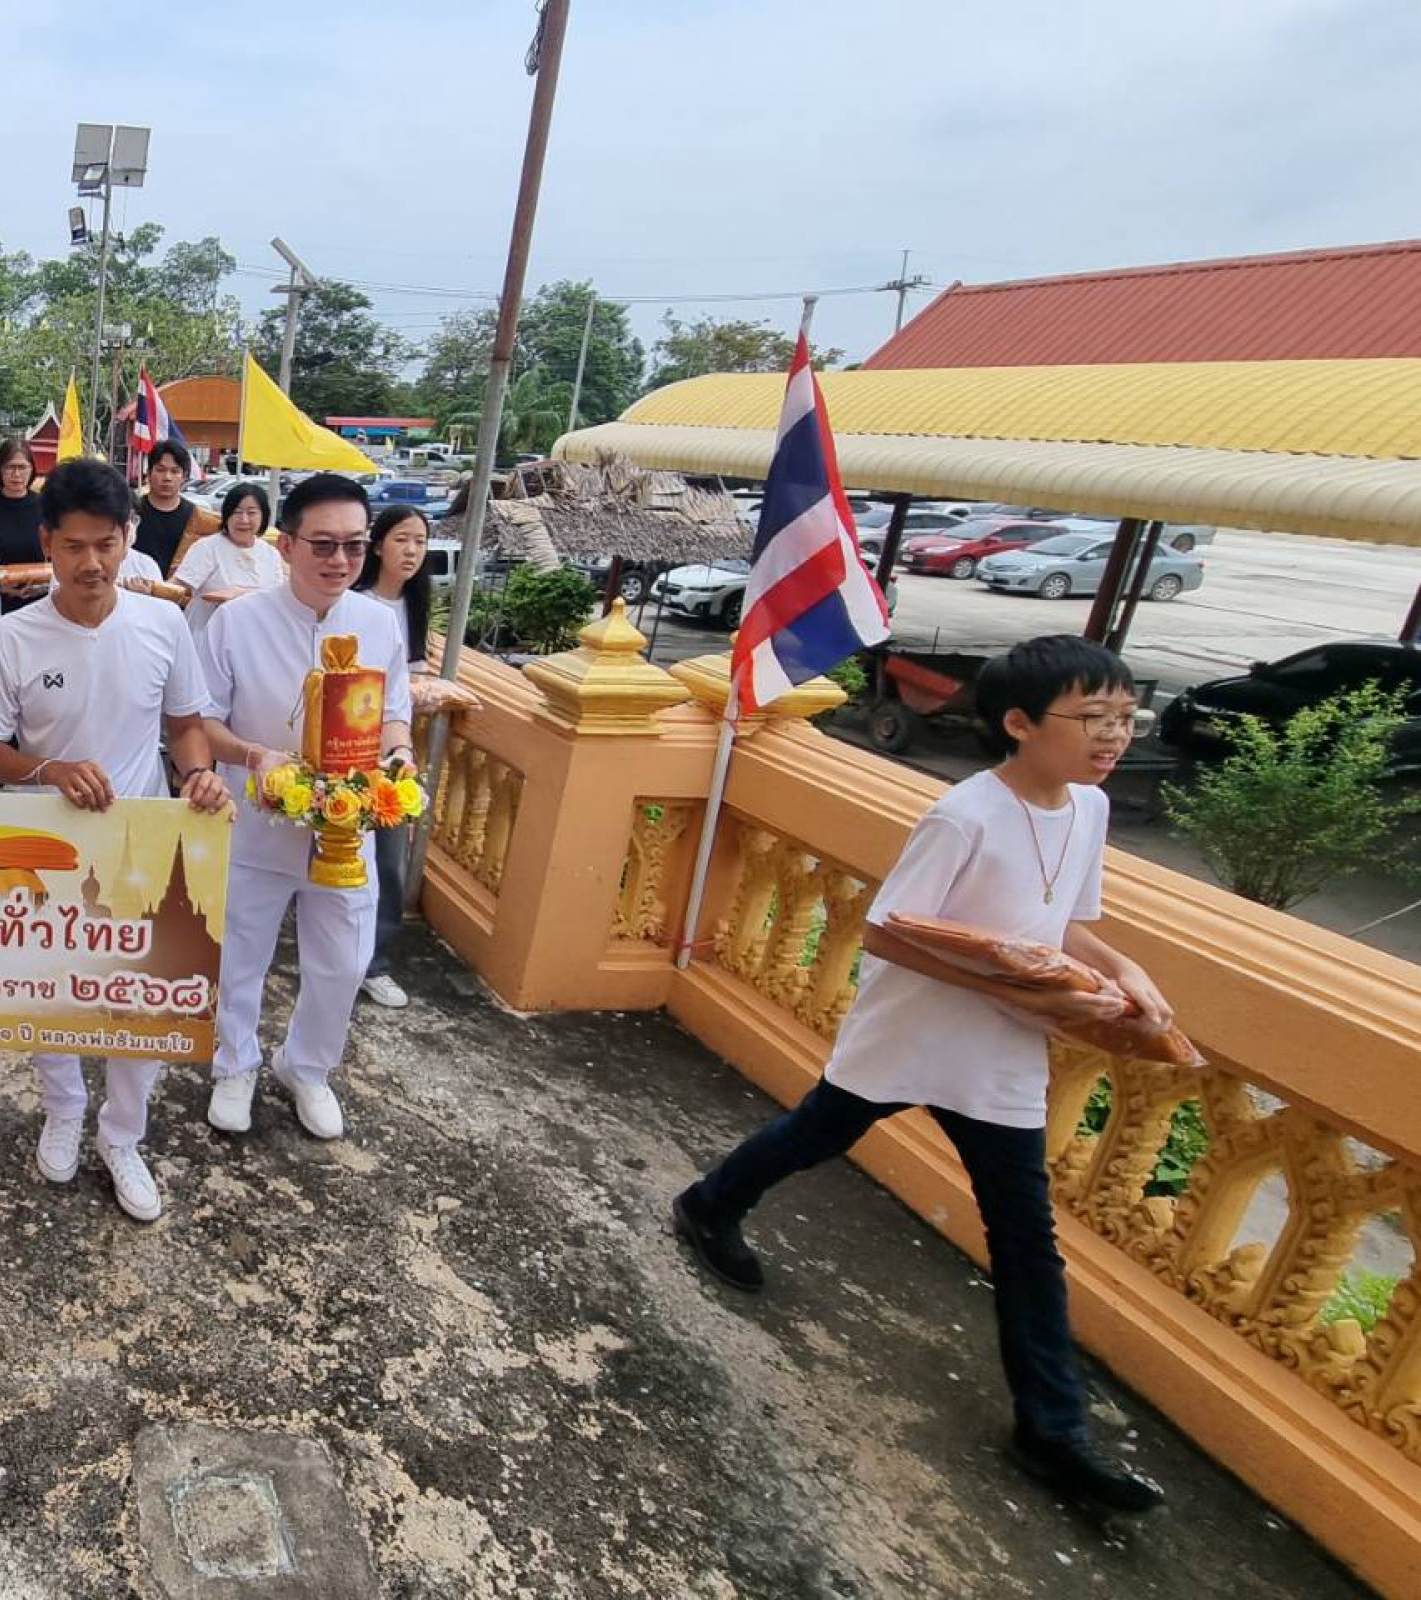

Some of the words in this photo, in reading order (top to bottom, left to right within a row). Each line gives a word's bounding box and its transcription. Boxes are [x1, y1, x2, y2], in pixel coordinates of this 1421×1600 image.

[70, 974, 203, 1007] ๒๕๖๘
[20, 1022, 34, 1041] ปี
[40, 1029, 193, 1052] หลวงพ่อธัมมชโย
